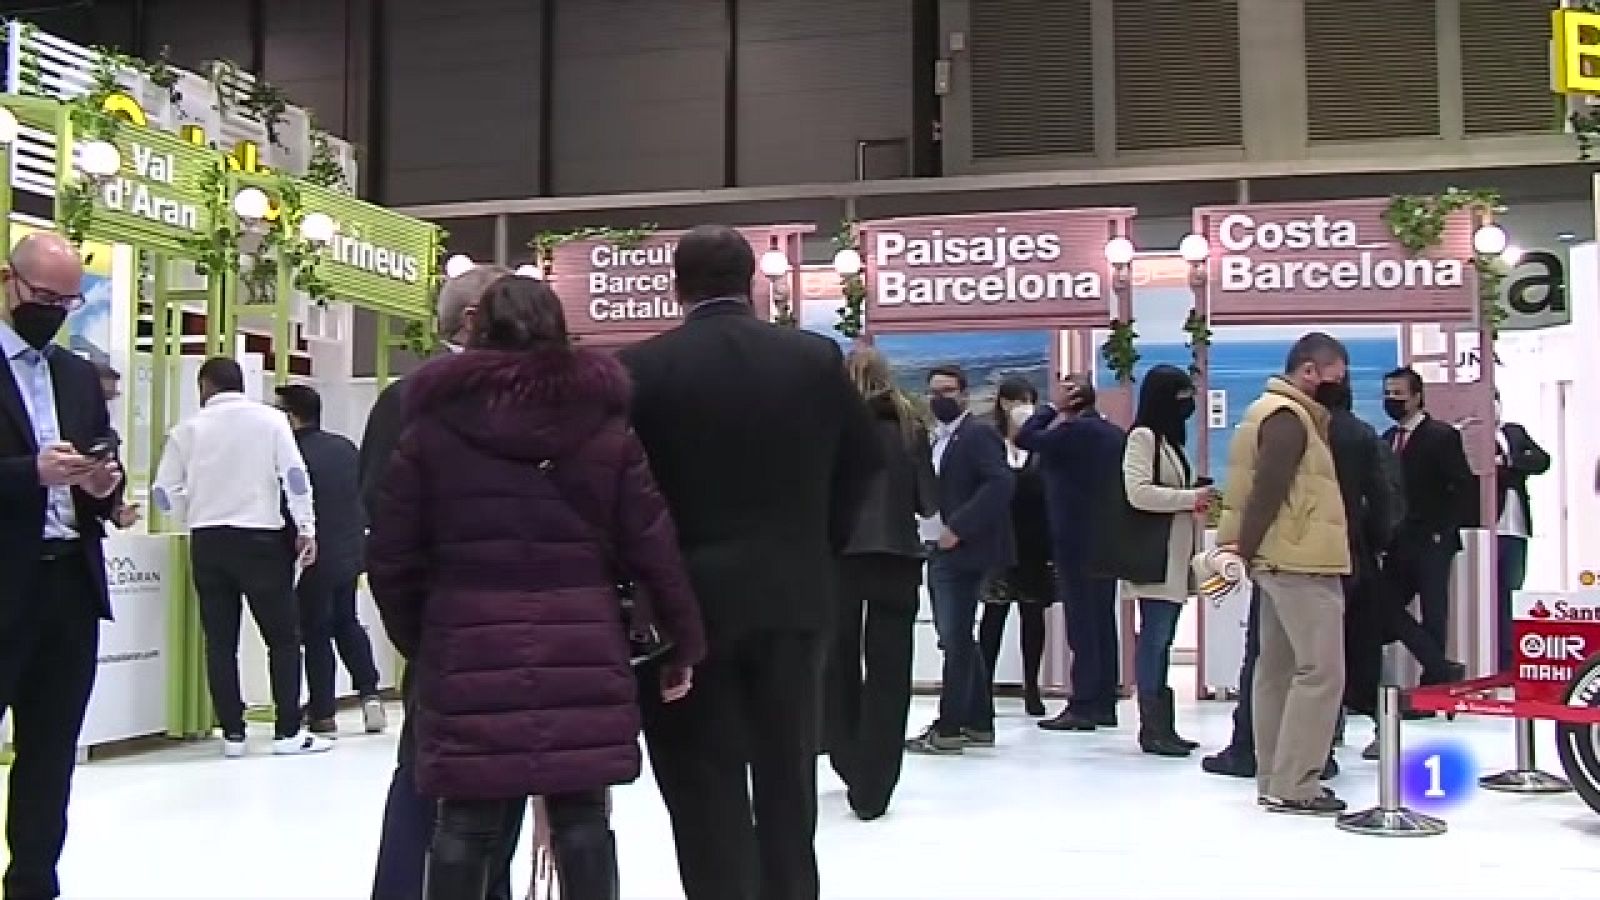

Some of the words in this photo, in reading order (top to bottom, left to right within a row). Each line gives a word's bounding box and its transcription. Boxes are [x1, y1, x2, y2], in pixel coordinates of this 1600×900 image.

[131, 142, 174, 183] Val
[104, 176, 196, 229] d'Aran
[332, 233, 417, 282] irineus
[590, 241, 678, 268] Circui
[875, 228, 1061, 268] Paisajes
[876, 267, 1101, 306] Barcelona
[1221, 251, 1464, 291] Barcelona
[589, 296, 683, 320] Catalu
